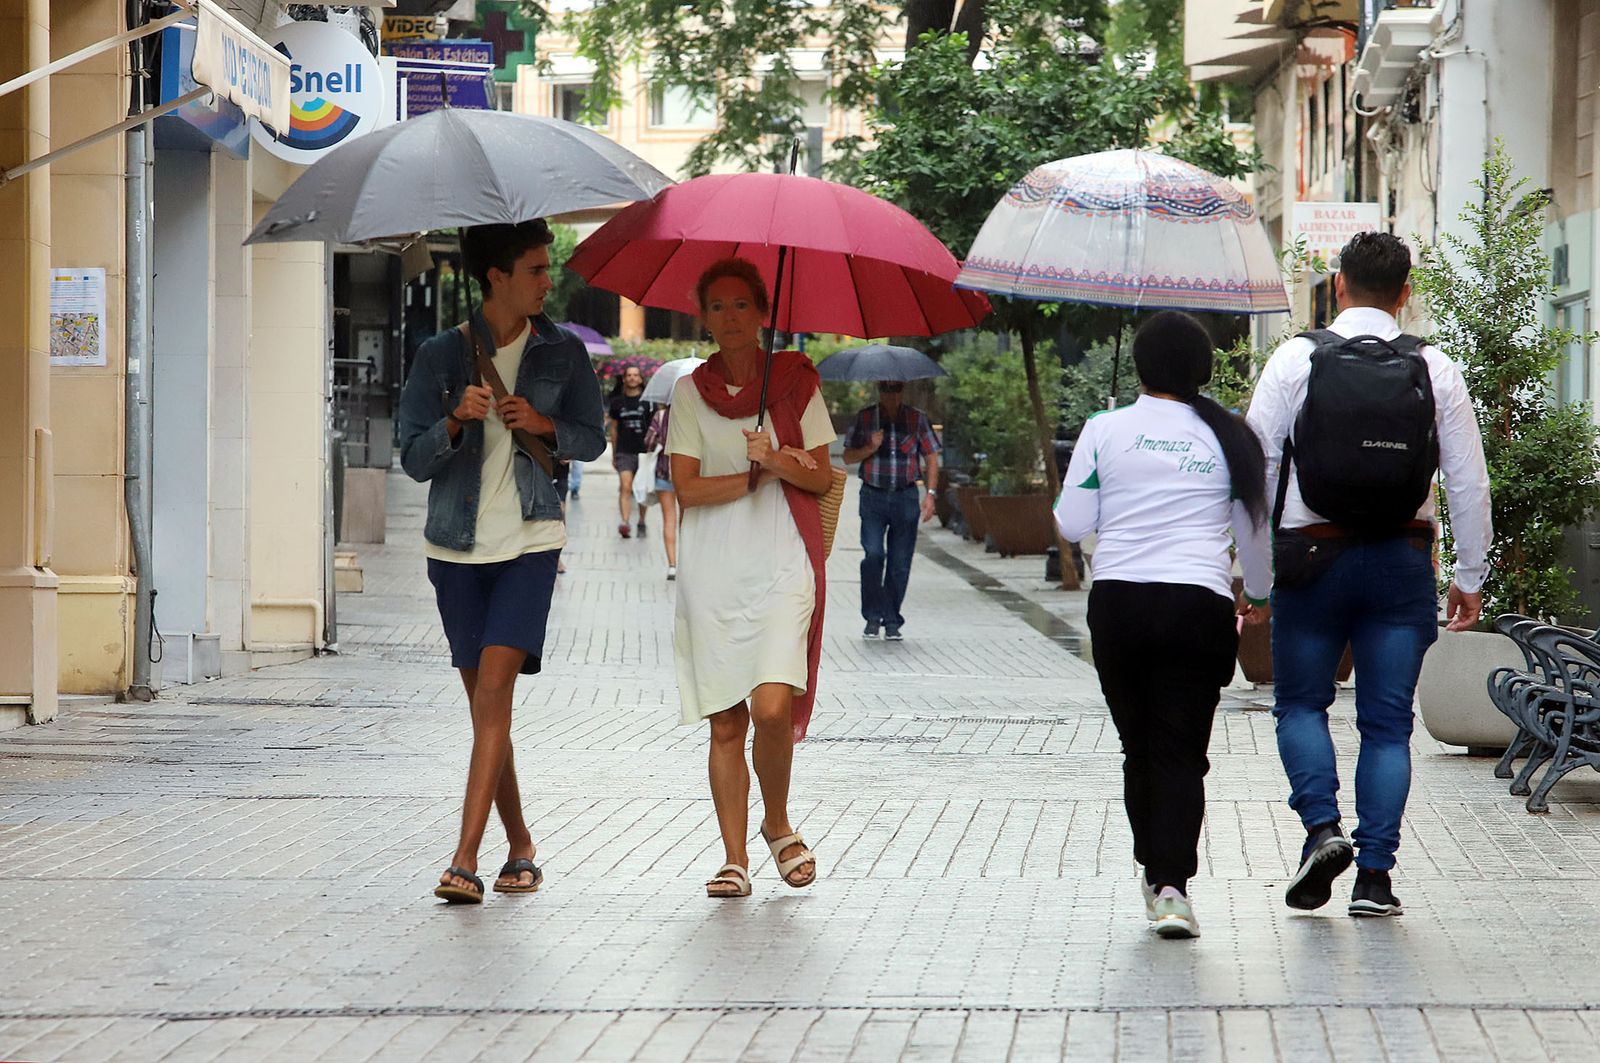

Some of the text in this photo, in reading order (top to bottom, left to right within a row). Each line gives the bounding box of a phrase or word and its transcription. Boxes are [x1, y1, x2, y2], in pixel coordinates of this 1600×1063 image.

[426, 47, 441, 60] De
[443, 47, 489, 63] Estética
[290, 64, 362, 94] Snell
[1314, 210, 1357, 219] BAZAR
[1124, 433, 1193, 453] Amenaza
[1361, 440, 1408, 451] DAKINE
[1178, 454, 1216, 474] Verde
